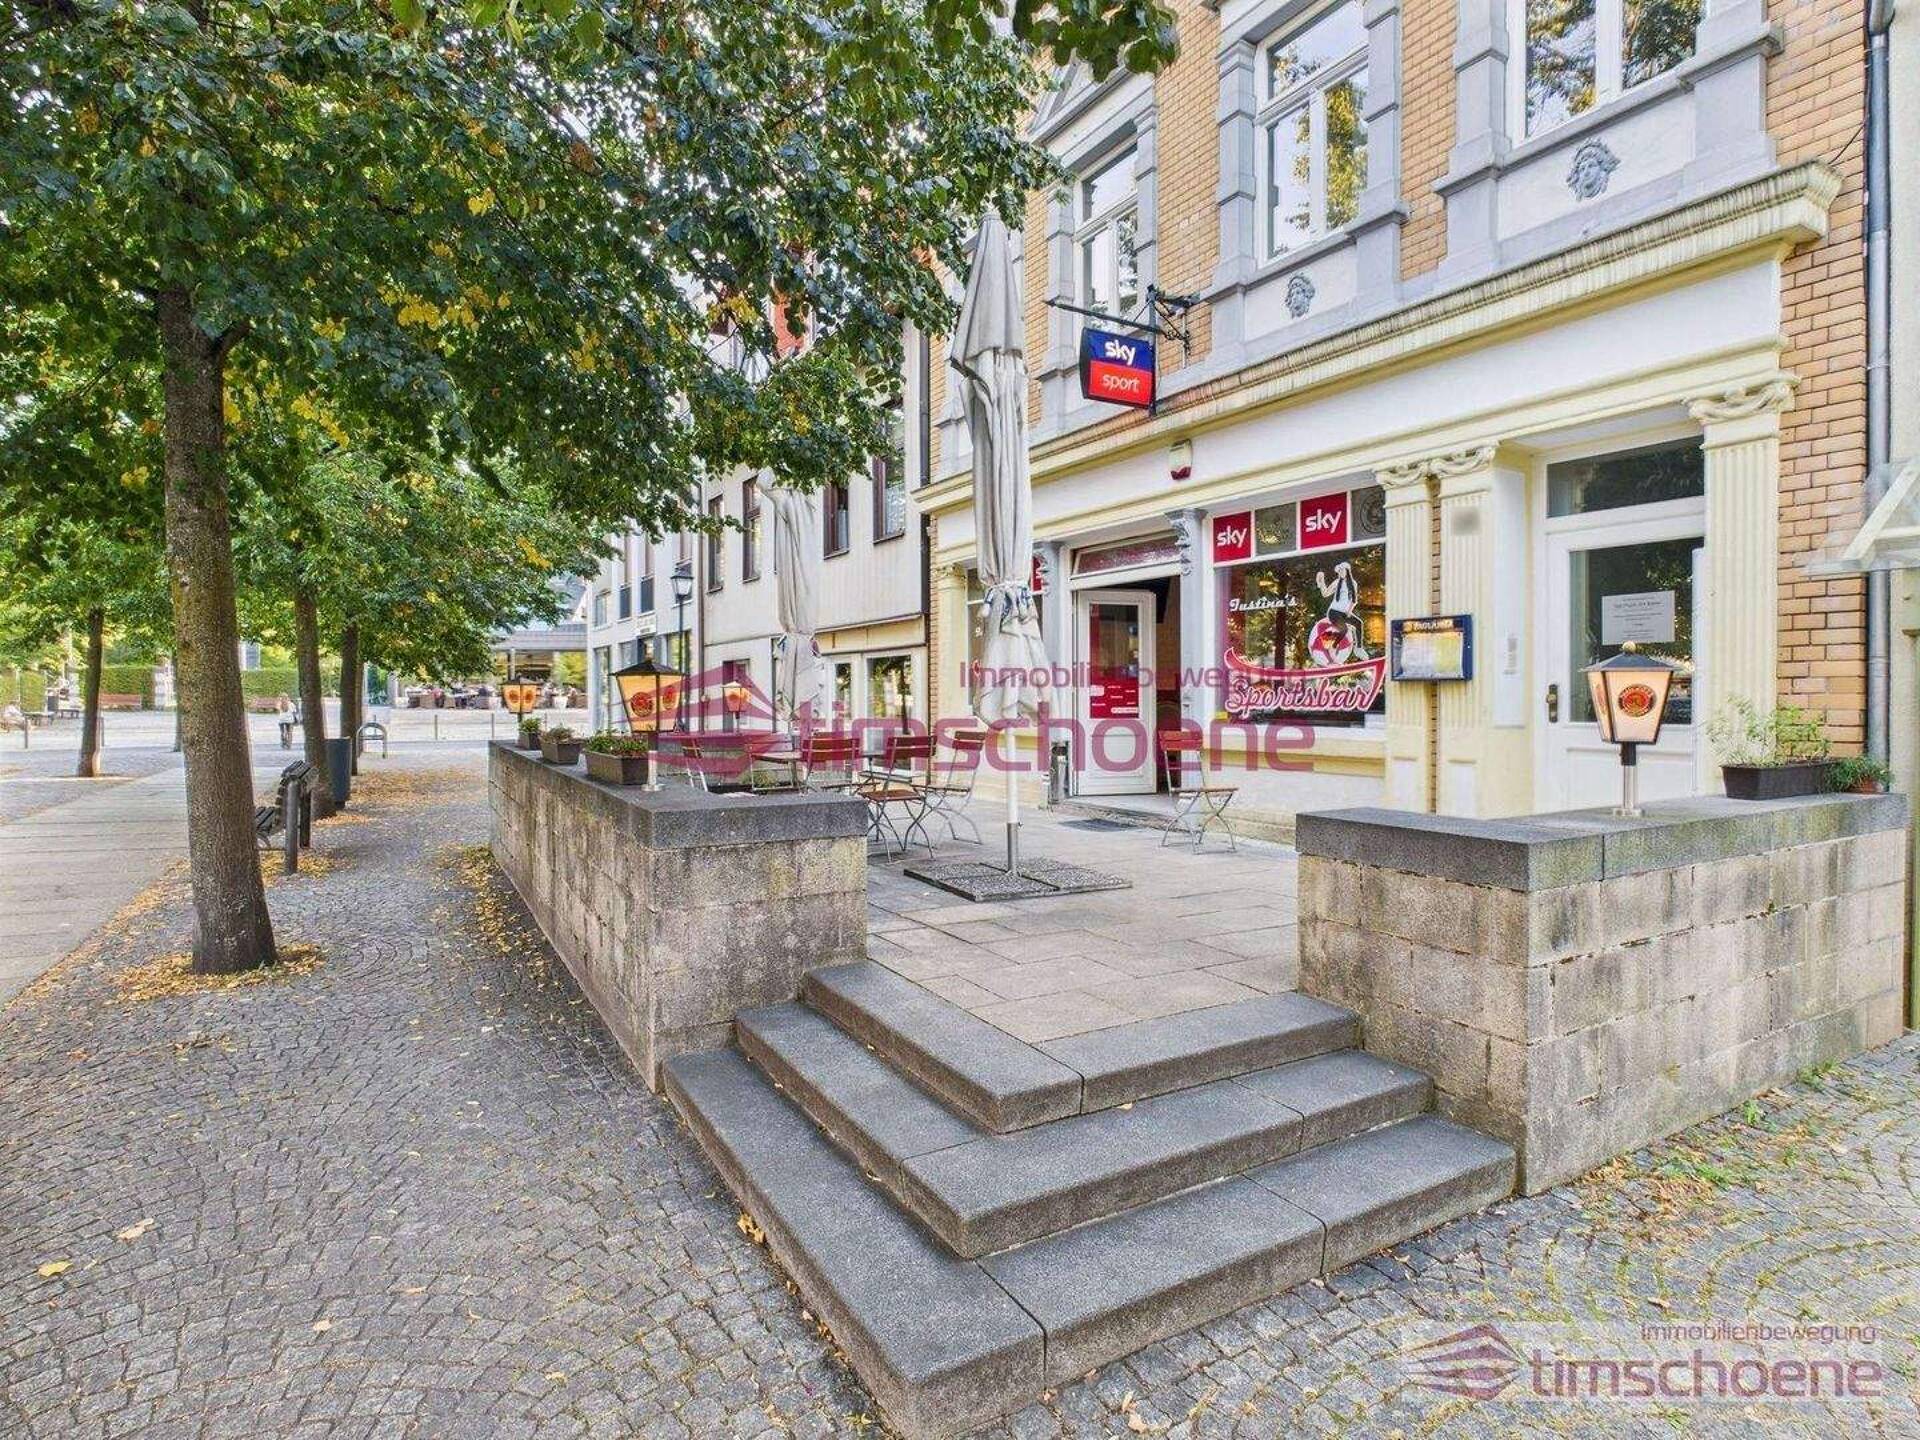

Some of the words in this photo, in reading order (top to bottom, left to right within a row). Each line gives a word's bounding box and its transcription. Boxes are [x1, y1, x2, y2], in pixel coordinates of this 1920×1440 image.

[1104, 339, 1136, 366] sky
[1102, 374, 1139, 392] sport
[1304, 508, 1341, 534] sky
[1216, 525, 1248, 548] sky
[1224, 676, 1376, 718] Sportsbar
